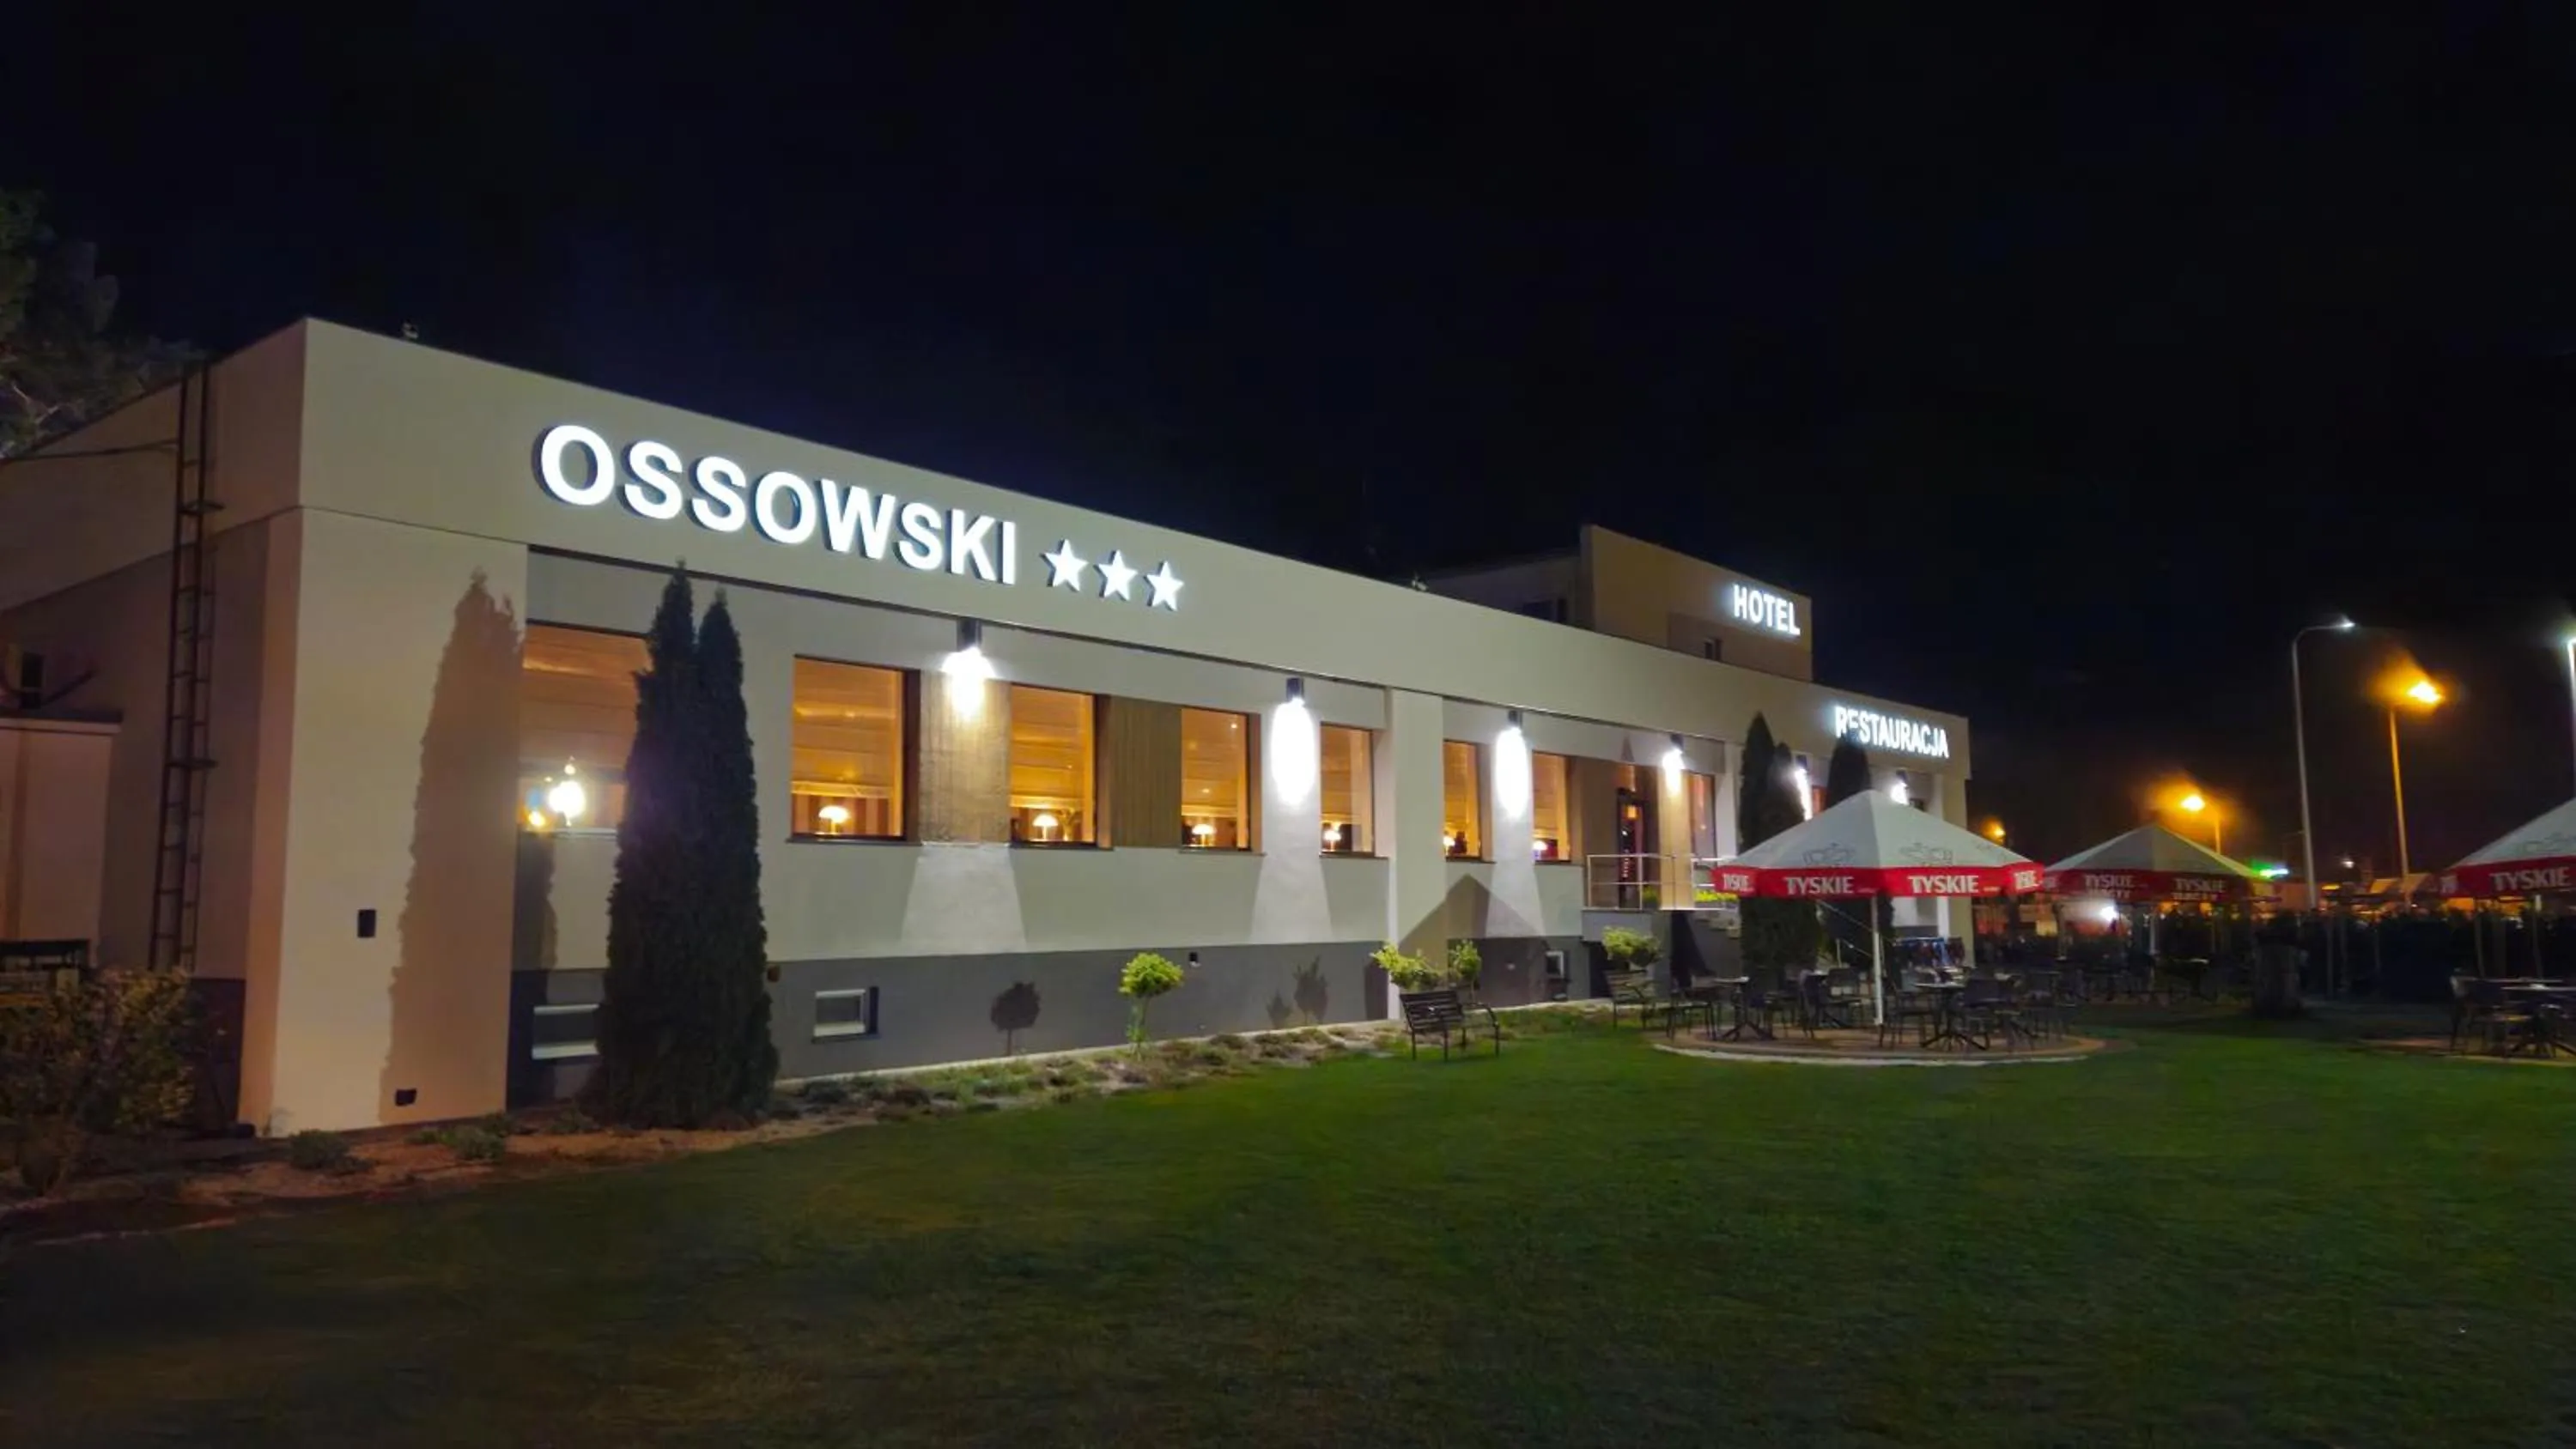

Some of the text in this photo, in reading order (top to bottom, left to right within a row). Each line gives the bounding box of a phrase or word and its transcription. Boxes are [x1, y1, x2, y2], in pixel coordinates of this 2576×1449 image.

[538, 424, 1017, 585] OSSOWSKI
[1732, 584, 1801, 636] HOTEL
[1834, 705, 1950, 759] RESTAURACJA
[1783, 876, 1855, 894] TYSKIE
[1907, 875, 1979, 894] TYSKIE
[2488, 867, 2572, 891] TYSKIE
